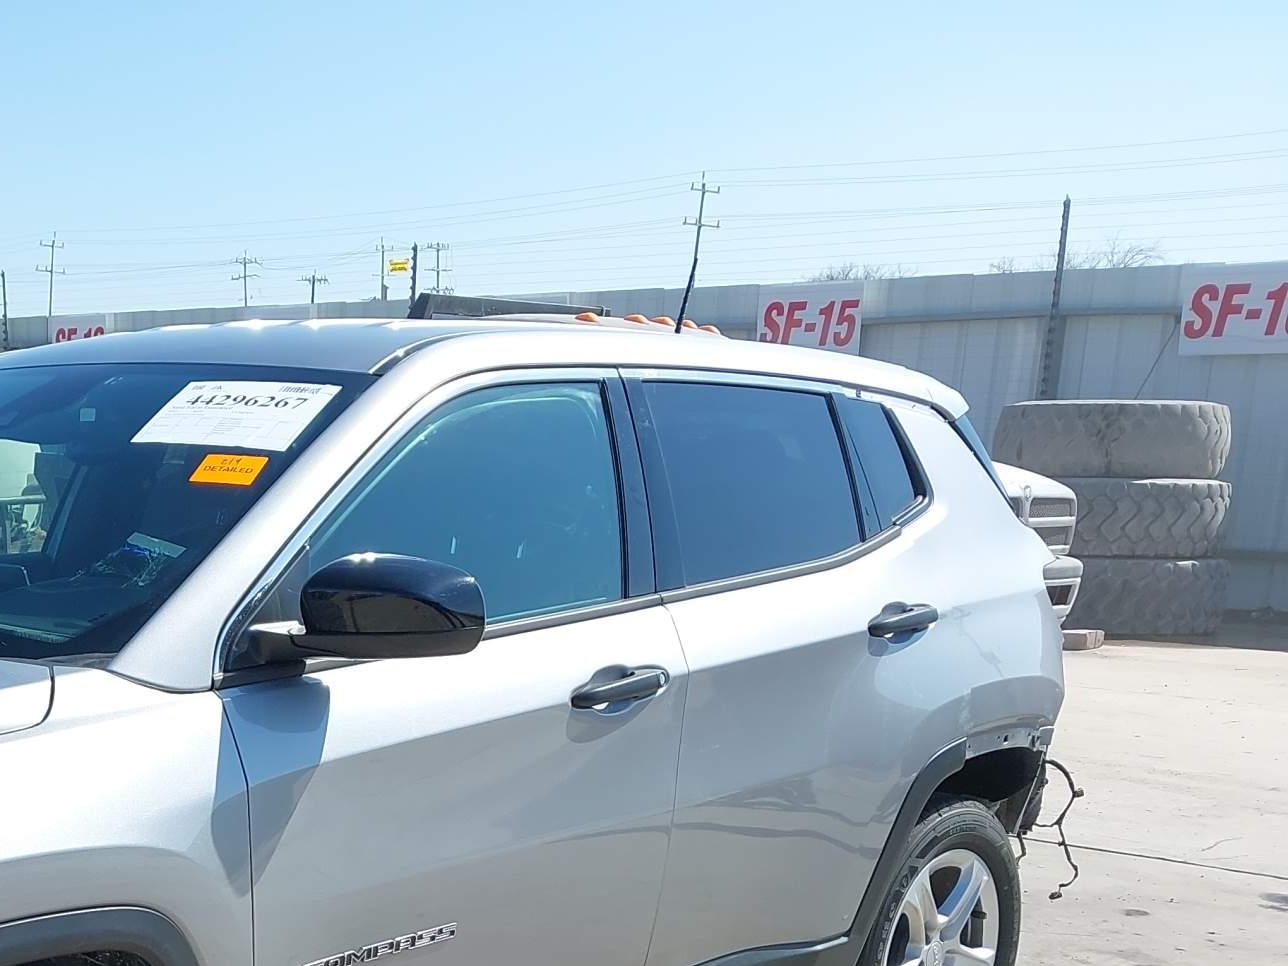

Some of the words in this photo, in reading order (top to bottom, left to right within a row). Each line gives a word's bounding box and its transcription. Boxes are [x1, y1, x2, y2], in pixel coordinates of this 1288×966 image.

[759, 299, 861, 347] SF-15
[1184, 282, 1288, 339] SF-1
[185, 394, 308, 410] 44296267
[203, 465, 253, 474] DETAILED
